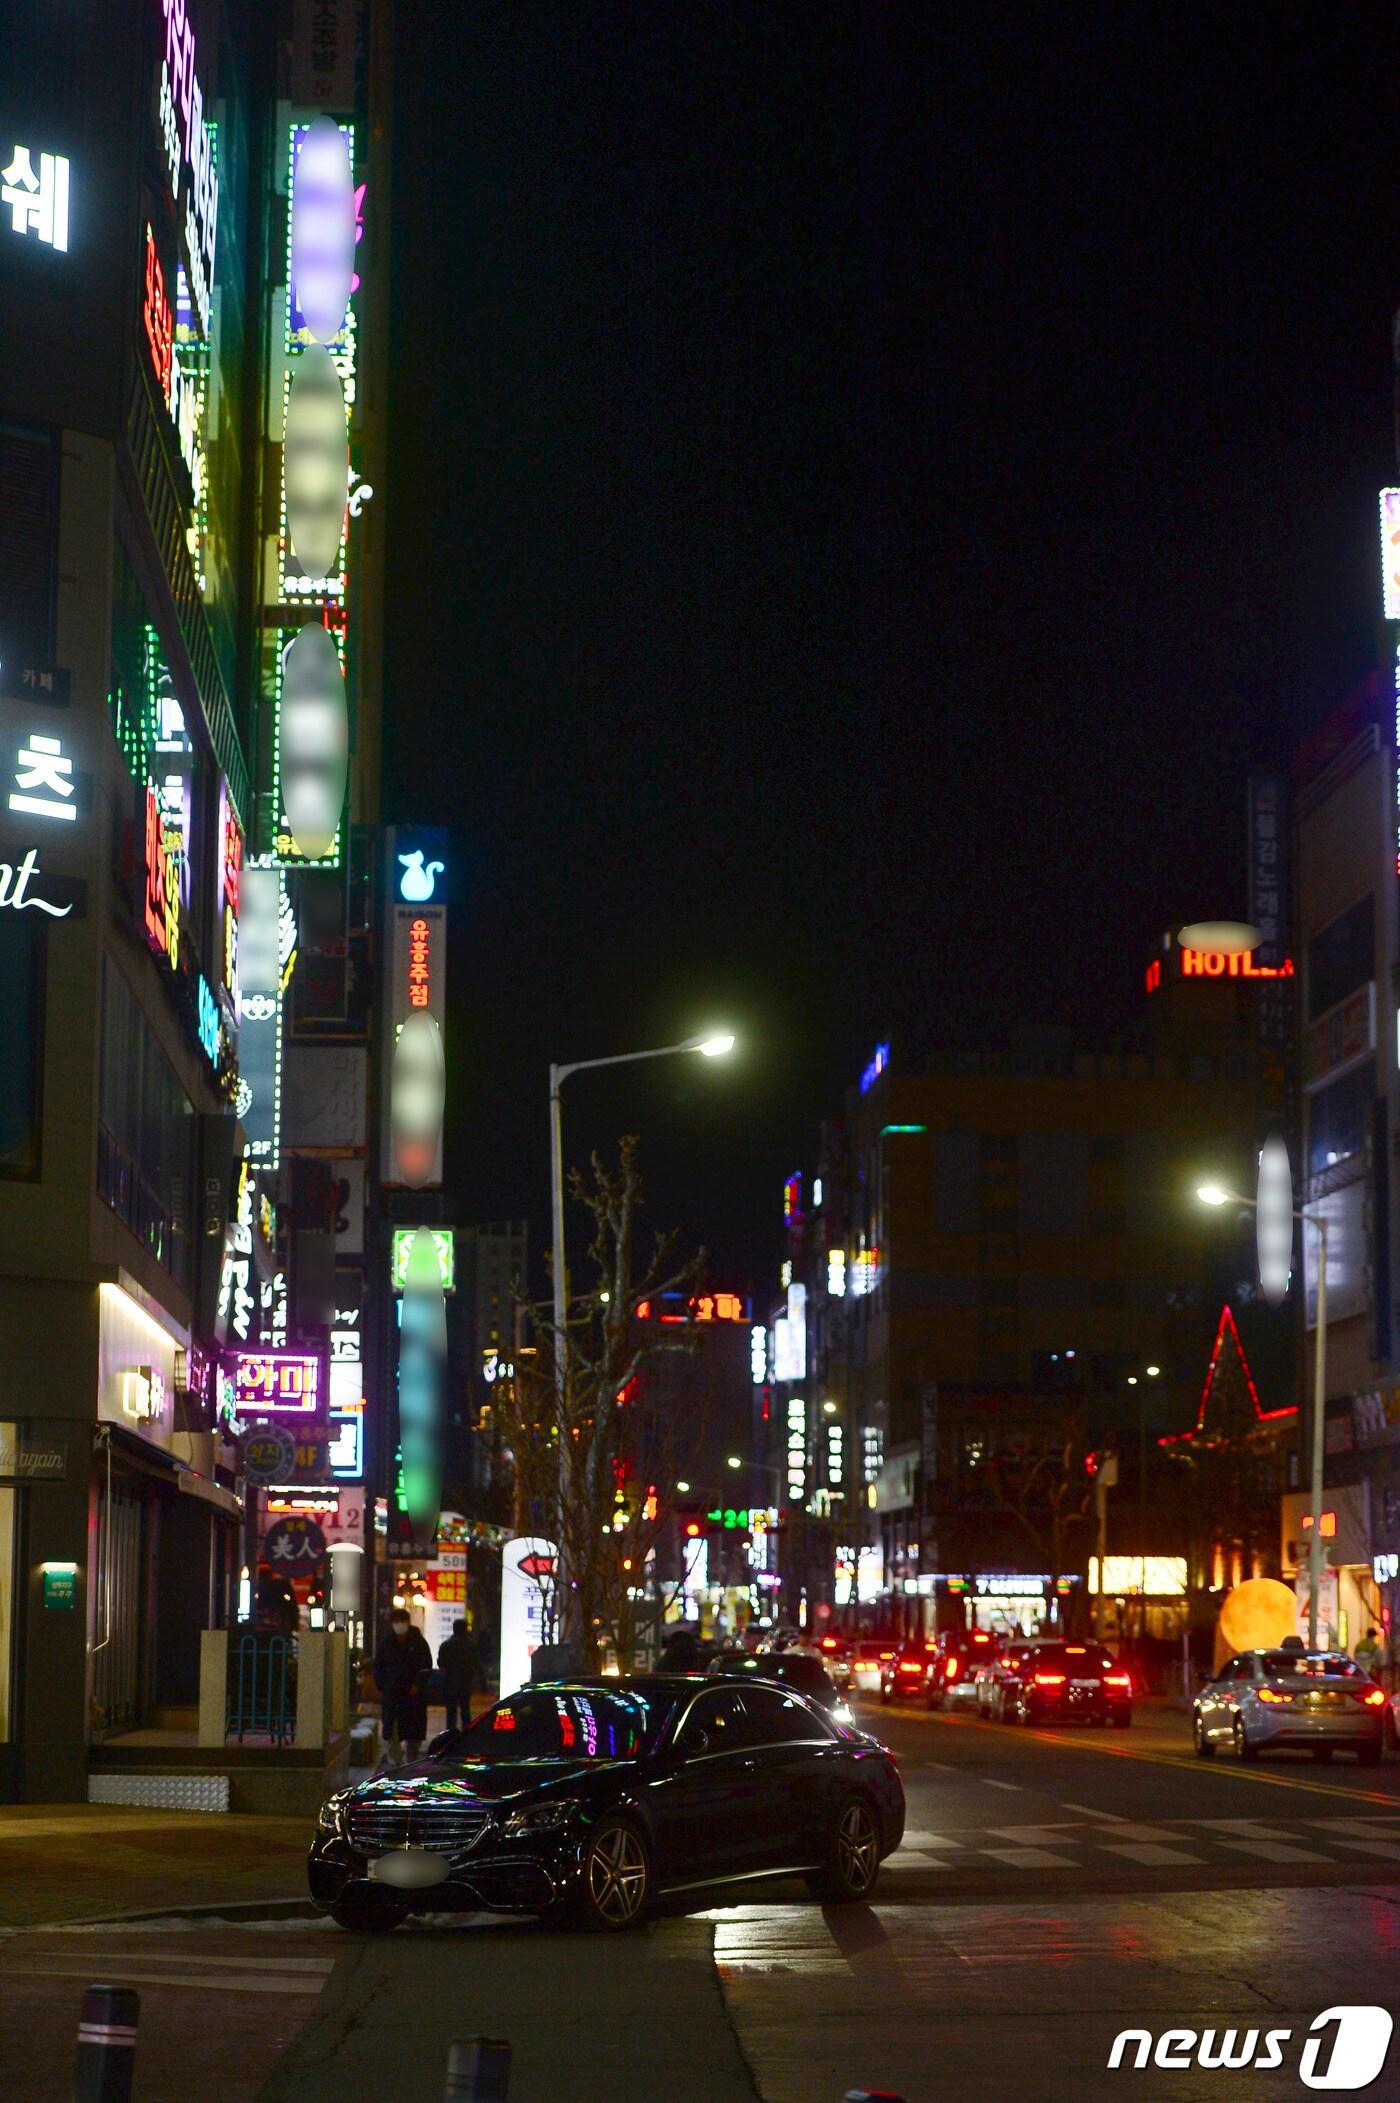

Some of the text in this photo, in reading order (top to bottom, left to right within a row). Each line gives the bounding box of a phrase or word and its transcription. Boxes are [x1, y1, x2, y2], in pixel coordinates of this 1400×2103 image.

[1, 145, 70, 253] 쉐
[22, 667, 53, 692] 카페
[8, 734, 77, 821] 츠
[409, 919, 430, 1008] 유흥주점
[251, 1140, 271, 1156] 2F
[272, 1534, 318, 1560] 美人
